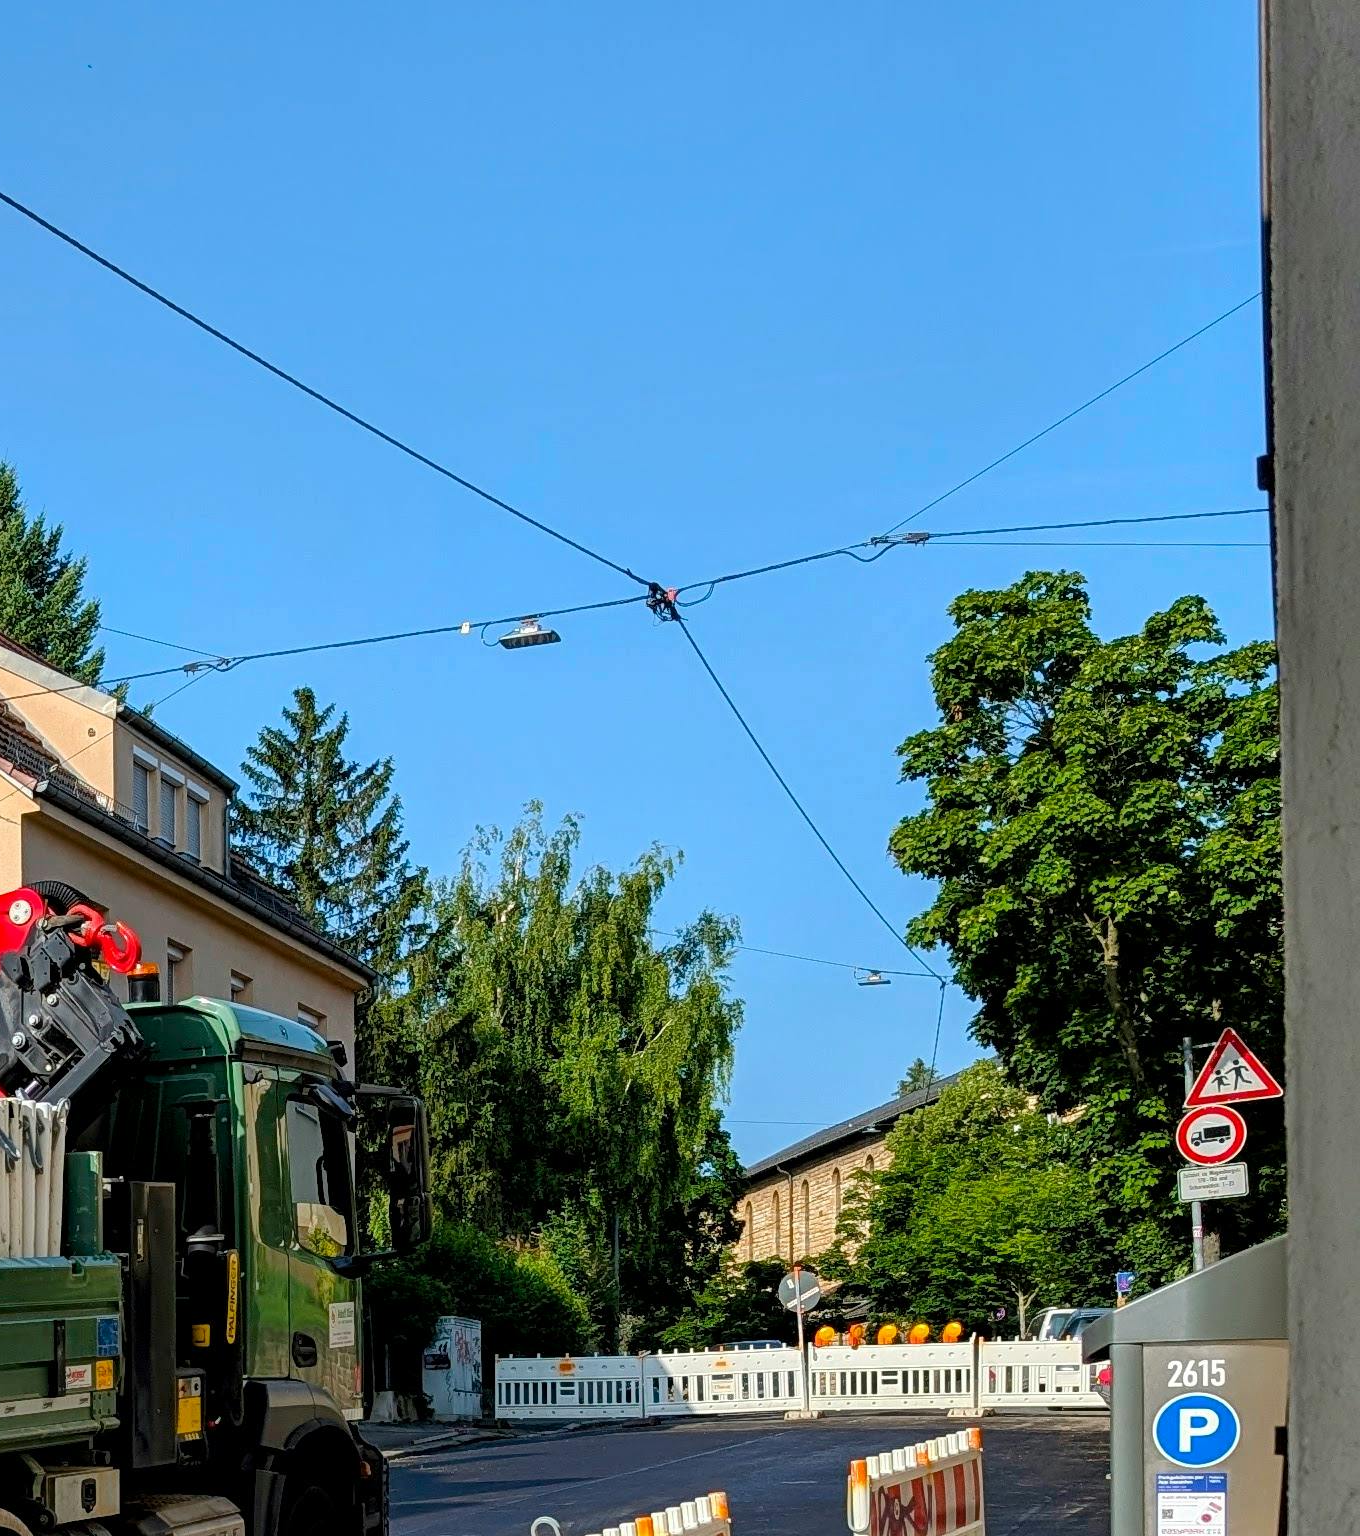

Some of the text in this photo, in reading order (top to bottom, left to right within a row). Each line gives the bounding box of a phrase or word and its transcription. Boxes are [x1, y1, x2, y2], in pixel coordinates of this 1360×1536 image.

[228, 1259, 237, 1339] PALFINGER
[1167, 1359, 1226, 1388] 2615
[1179, 1408, 1220, 1453] P
